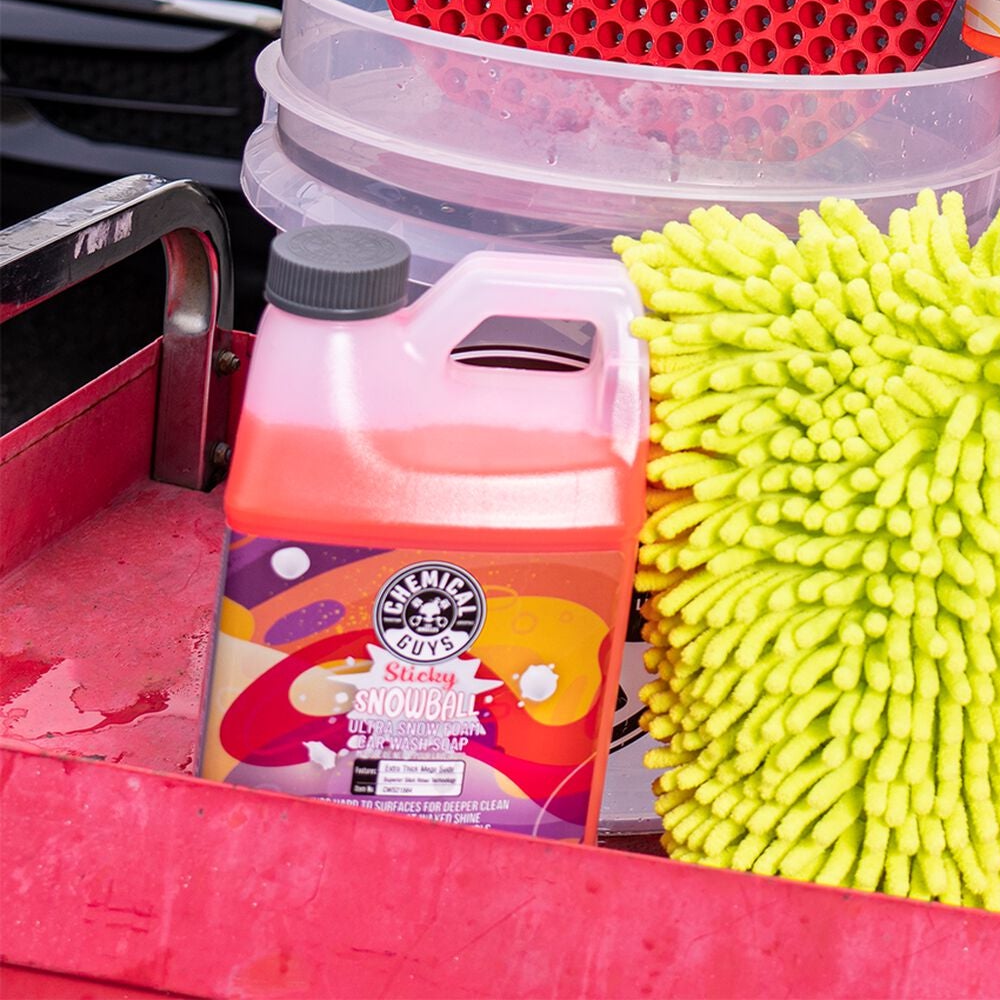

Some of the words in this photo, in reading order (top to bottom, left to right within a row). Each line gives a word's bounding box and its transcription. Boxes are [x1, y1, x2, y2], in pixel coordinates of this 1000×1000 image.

[383, 570, 477, 617] CHEMICAL
[396, 634, 454, 656] GUYS
[384, 660, 456, 690] Sticky
[354, 687, 480, 720] SNOWBALL
[348, 720, 393, 734] ULTRA
[399, 721, 440, 735] SNOW
[357, 735, 384, 750] CAR
[391, 736, 428, 751] WASH
[432, 737, 469, 751] SOAP
[375, 801, 422, 812] SURFACES
[423, 802, 442, 812] FOR
[443, 801, 479, 812] DEEPER
[480, 800, 510, 811] CLEAN
[453, 812, 481, 824] SHINE
